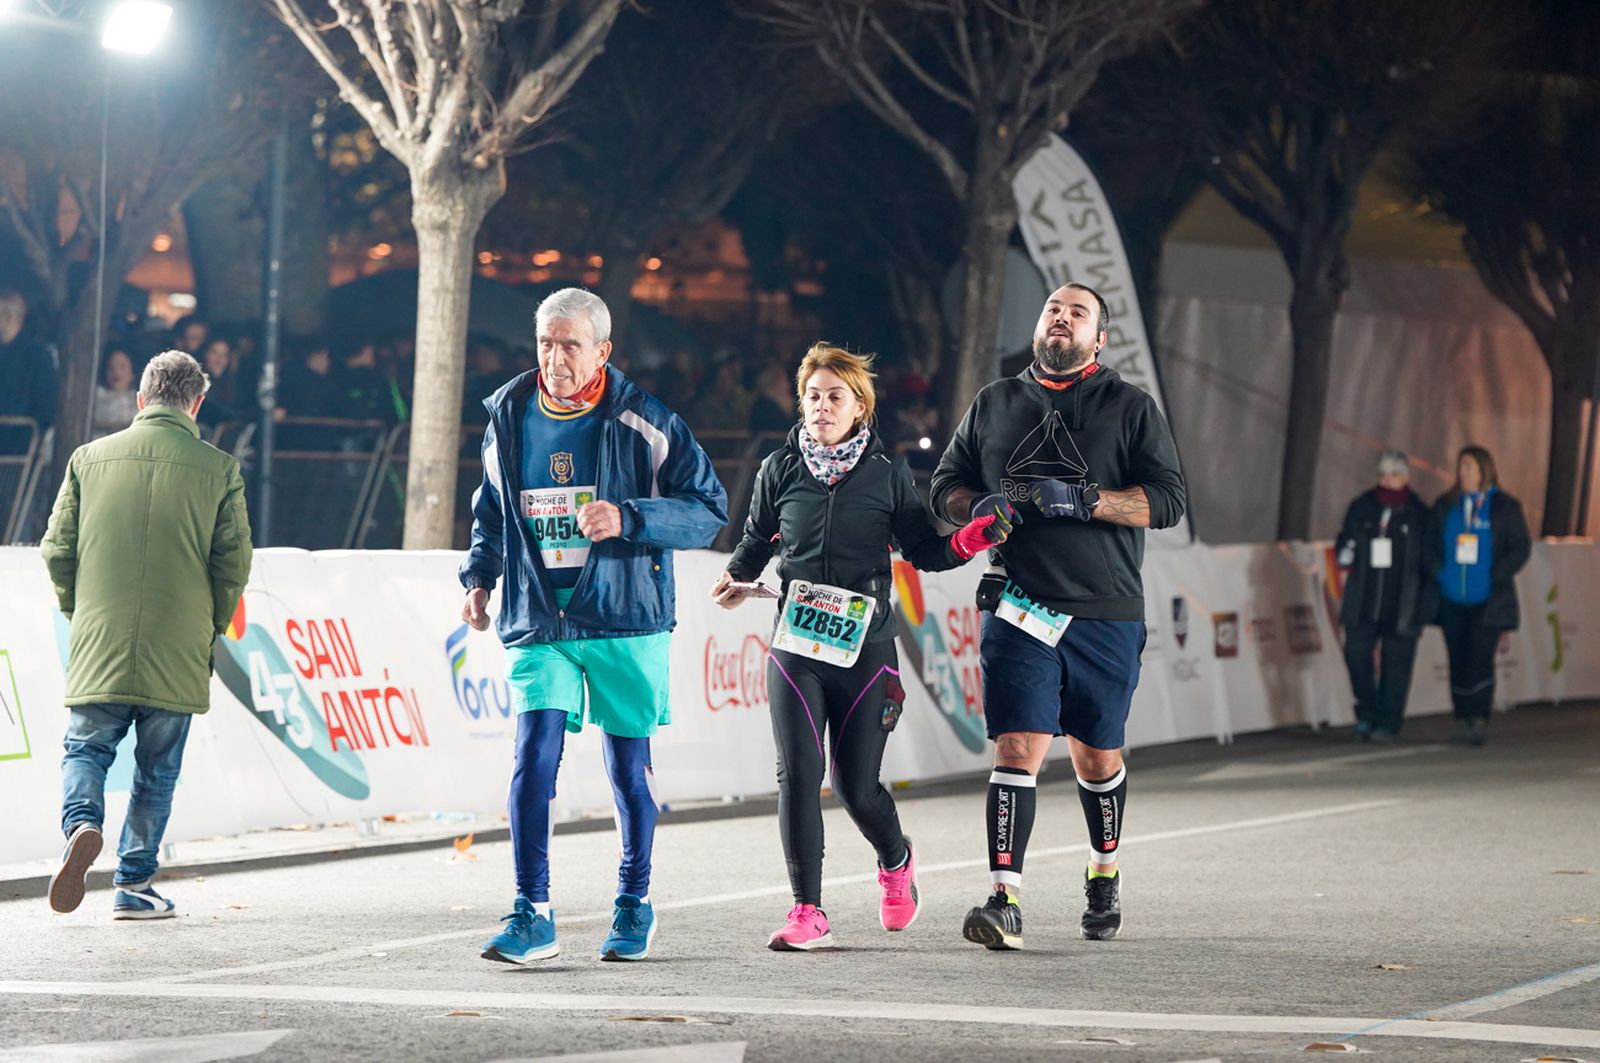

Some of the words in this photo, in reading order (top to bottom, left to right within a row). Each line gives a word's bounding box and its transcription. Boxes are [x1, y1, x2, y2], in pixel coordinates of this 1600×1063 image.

[527, 508, 541, 517] SAN
[536, 496, 557, 506] NOCHE
[558, 496, 568, 505] DE
[534, 517, 585, 541] 9454
[795, 595, 814, 608] SAN
[807, 589, 833, 603] NOCHE
[833, 595, 844, 605] DE
[793, 606, 858, 643] 12852
[286, 618, 362, 679] SAN
[248, 651, 313, 749] 43
[321, 668, 430, 752] ANTÓN
